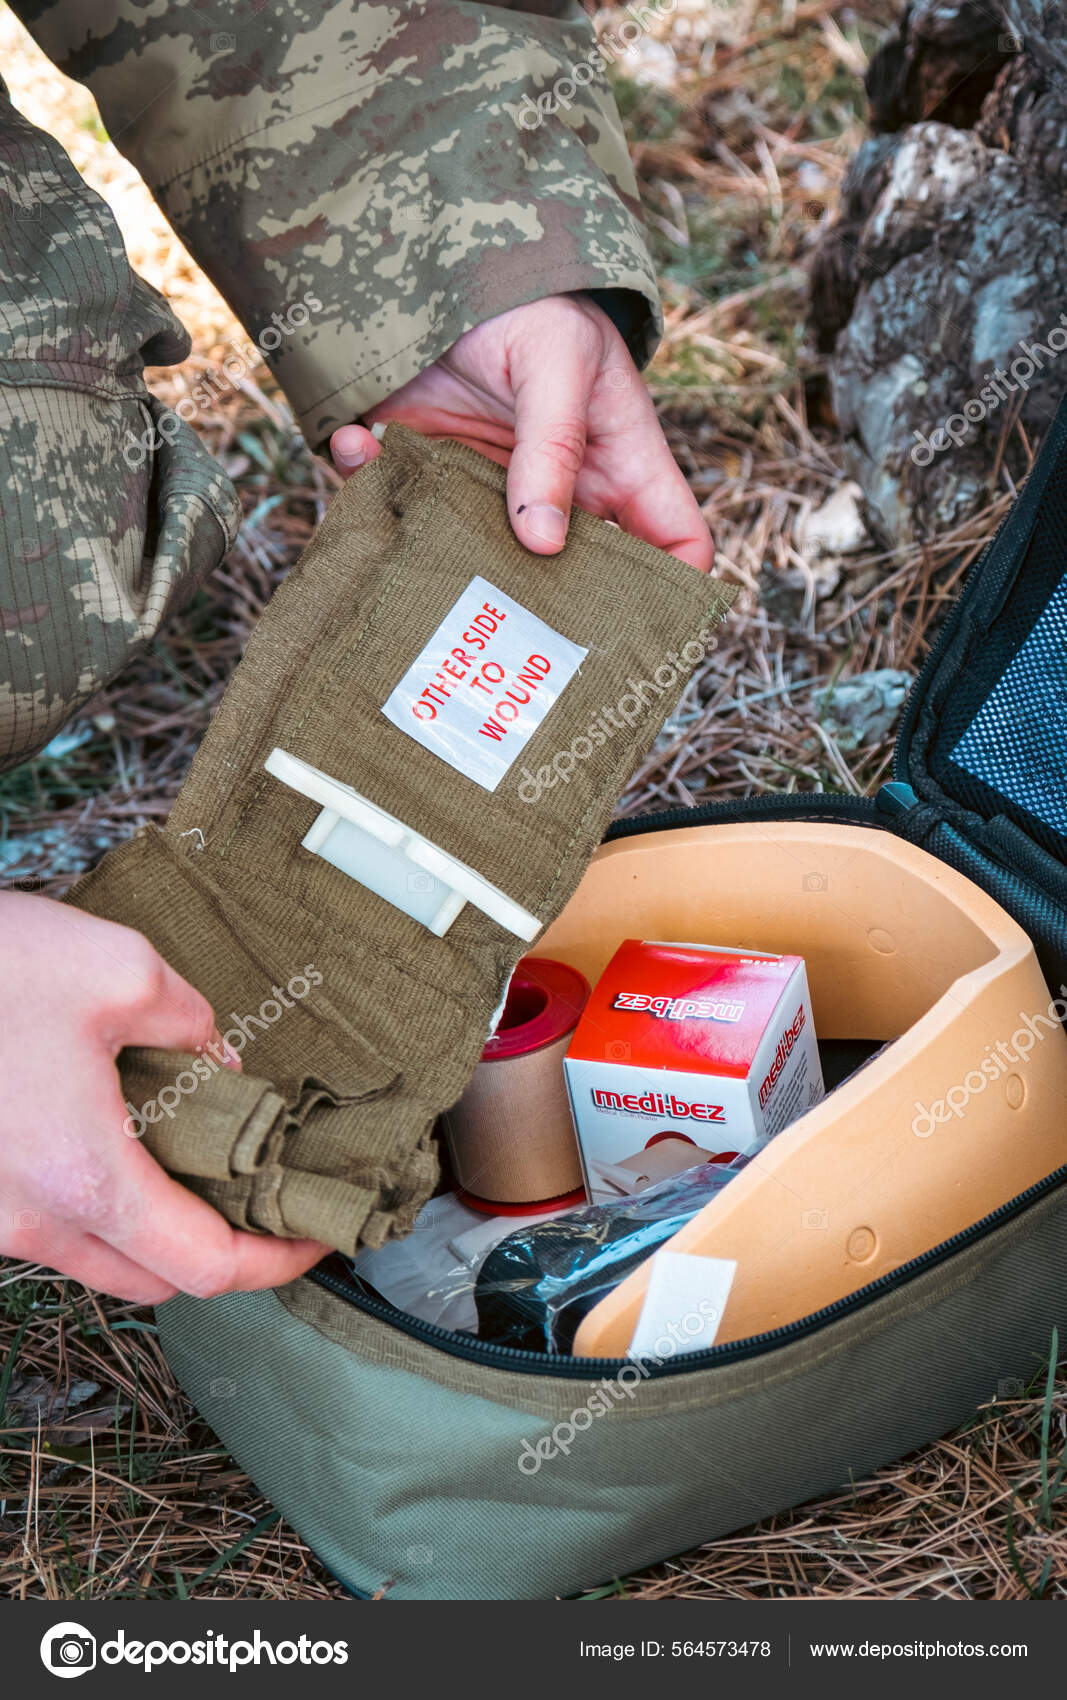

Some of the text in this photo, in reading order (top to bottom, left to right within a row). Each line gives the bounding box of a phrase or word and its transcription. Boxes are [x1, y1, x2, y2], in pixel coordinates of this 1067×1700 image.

[412, 602, 507, 722] OTHER SIDE
[469, 661, 506, 696] TO
[478, 653, 552, 743] WOUND
[615, 993, 745, 1022] medi-bez
[759, 1003, 806, 1110] medi-bez
[592, 1088, 728, 1124] medi-bez
